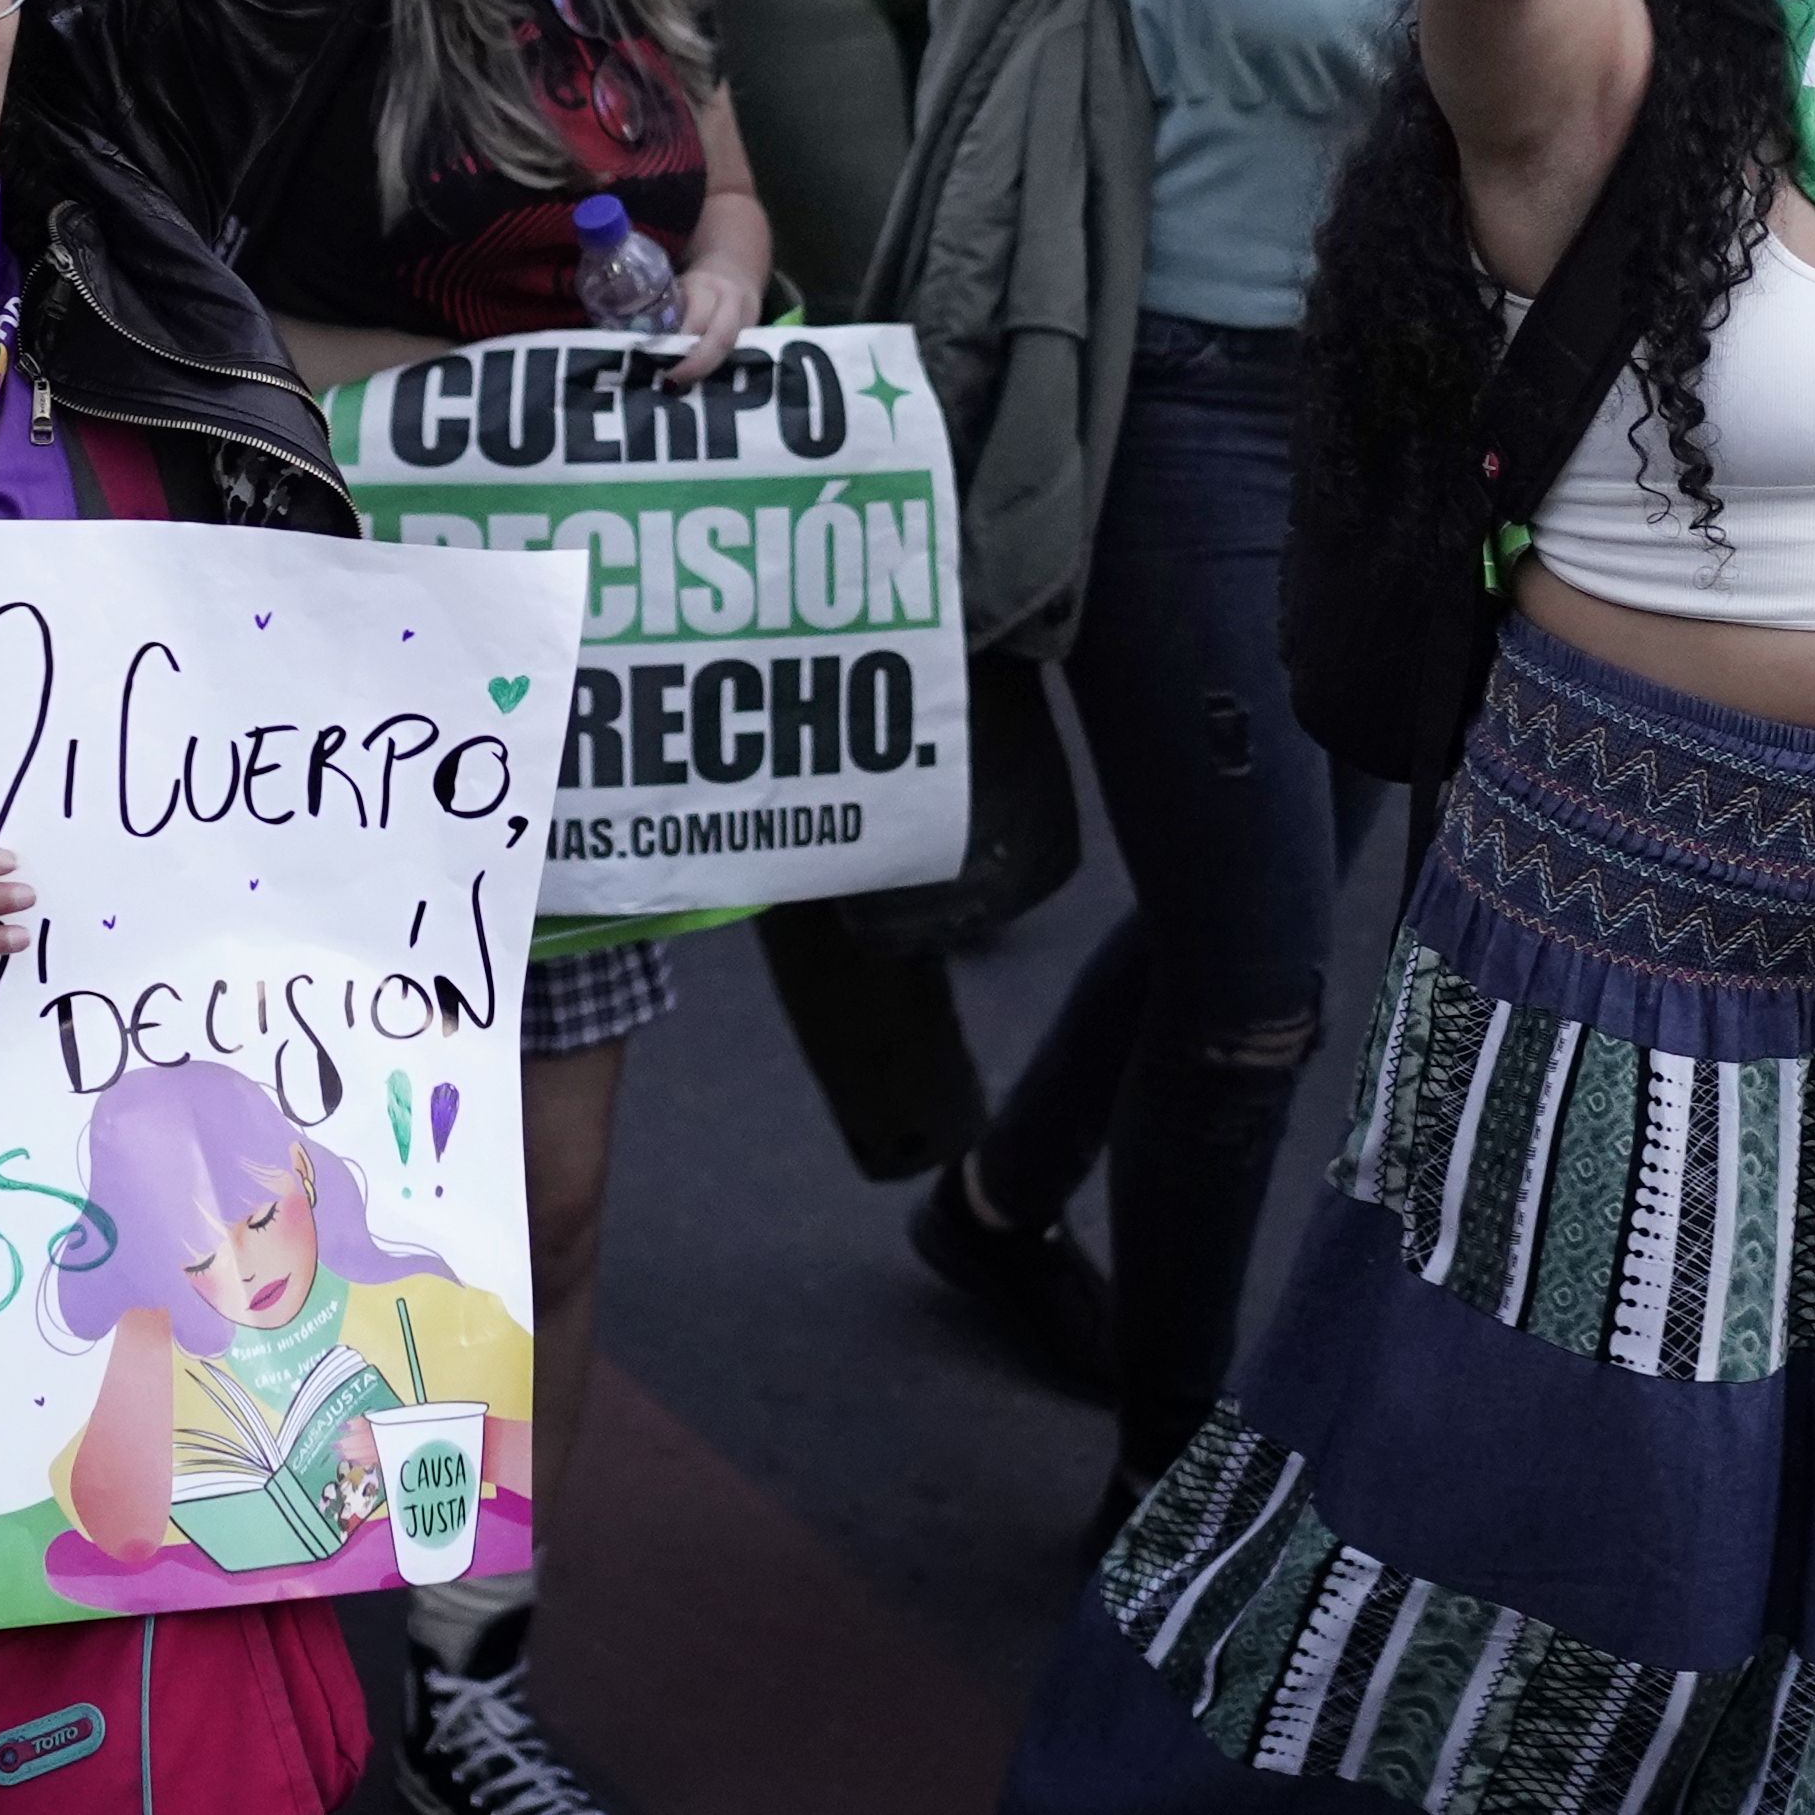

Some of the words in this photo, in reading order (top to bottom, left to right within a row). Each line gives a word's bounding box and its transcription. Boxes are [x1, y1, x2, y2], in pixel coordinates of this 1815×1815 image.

[390, 339, 847, 467] CUERPO
[401, 479, 937, 642] CISIÓN
[560, 650, 936, 789] RECHO.
[39, 870, 496, 1127] DECISIÓN
[399, 1452, 467, 1493] CAUSA
[402, 1495, 467, 1538] JUSTA
